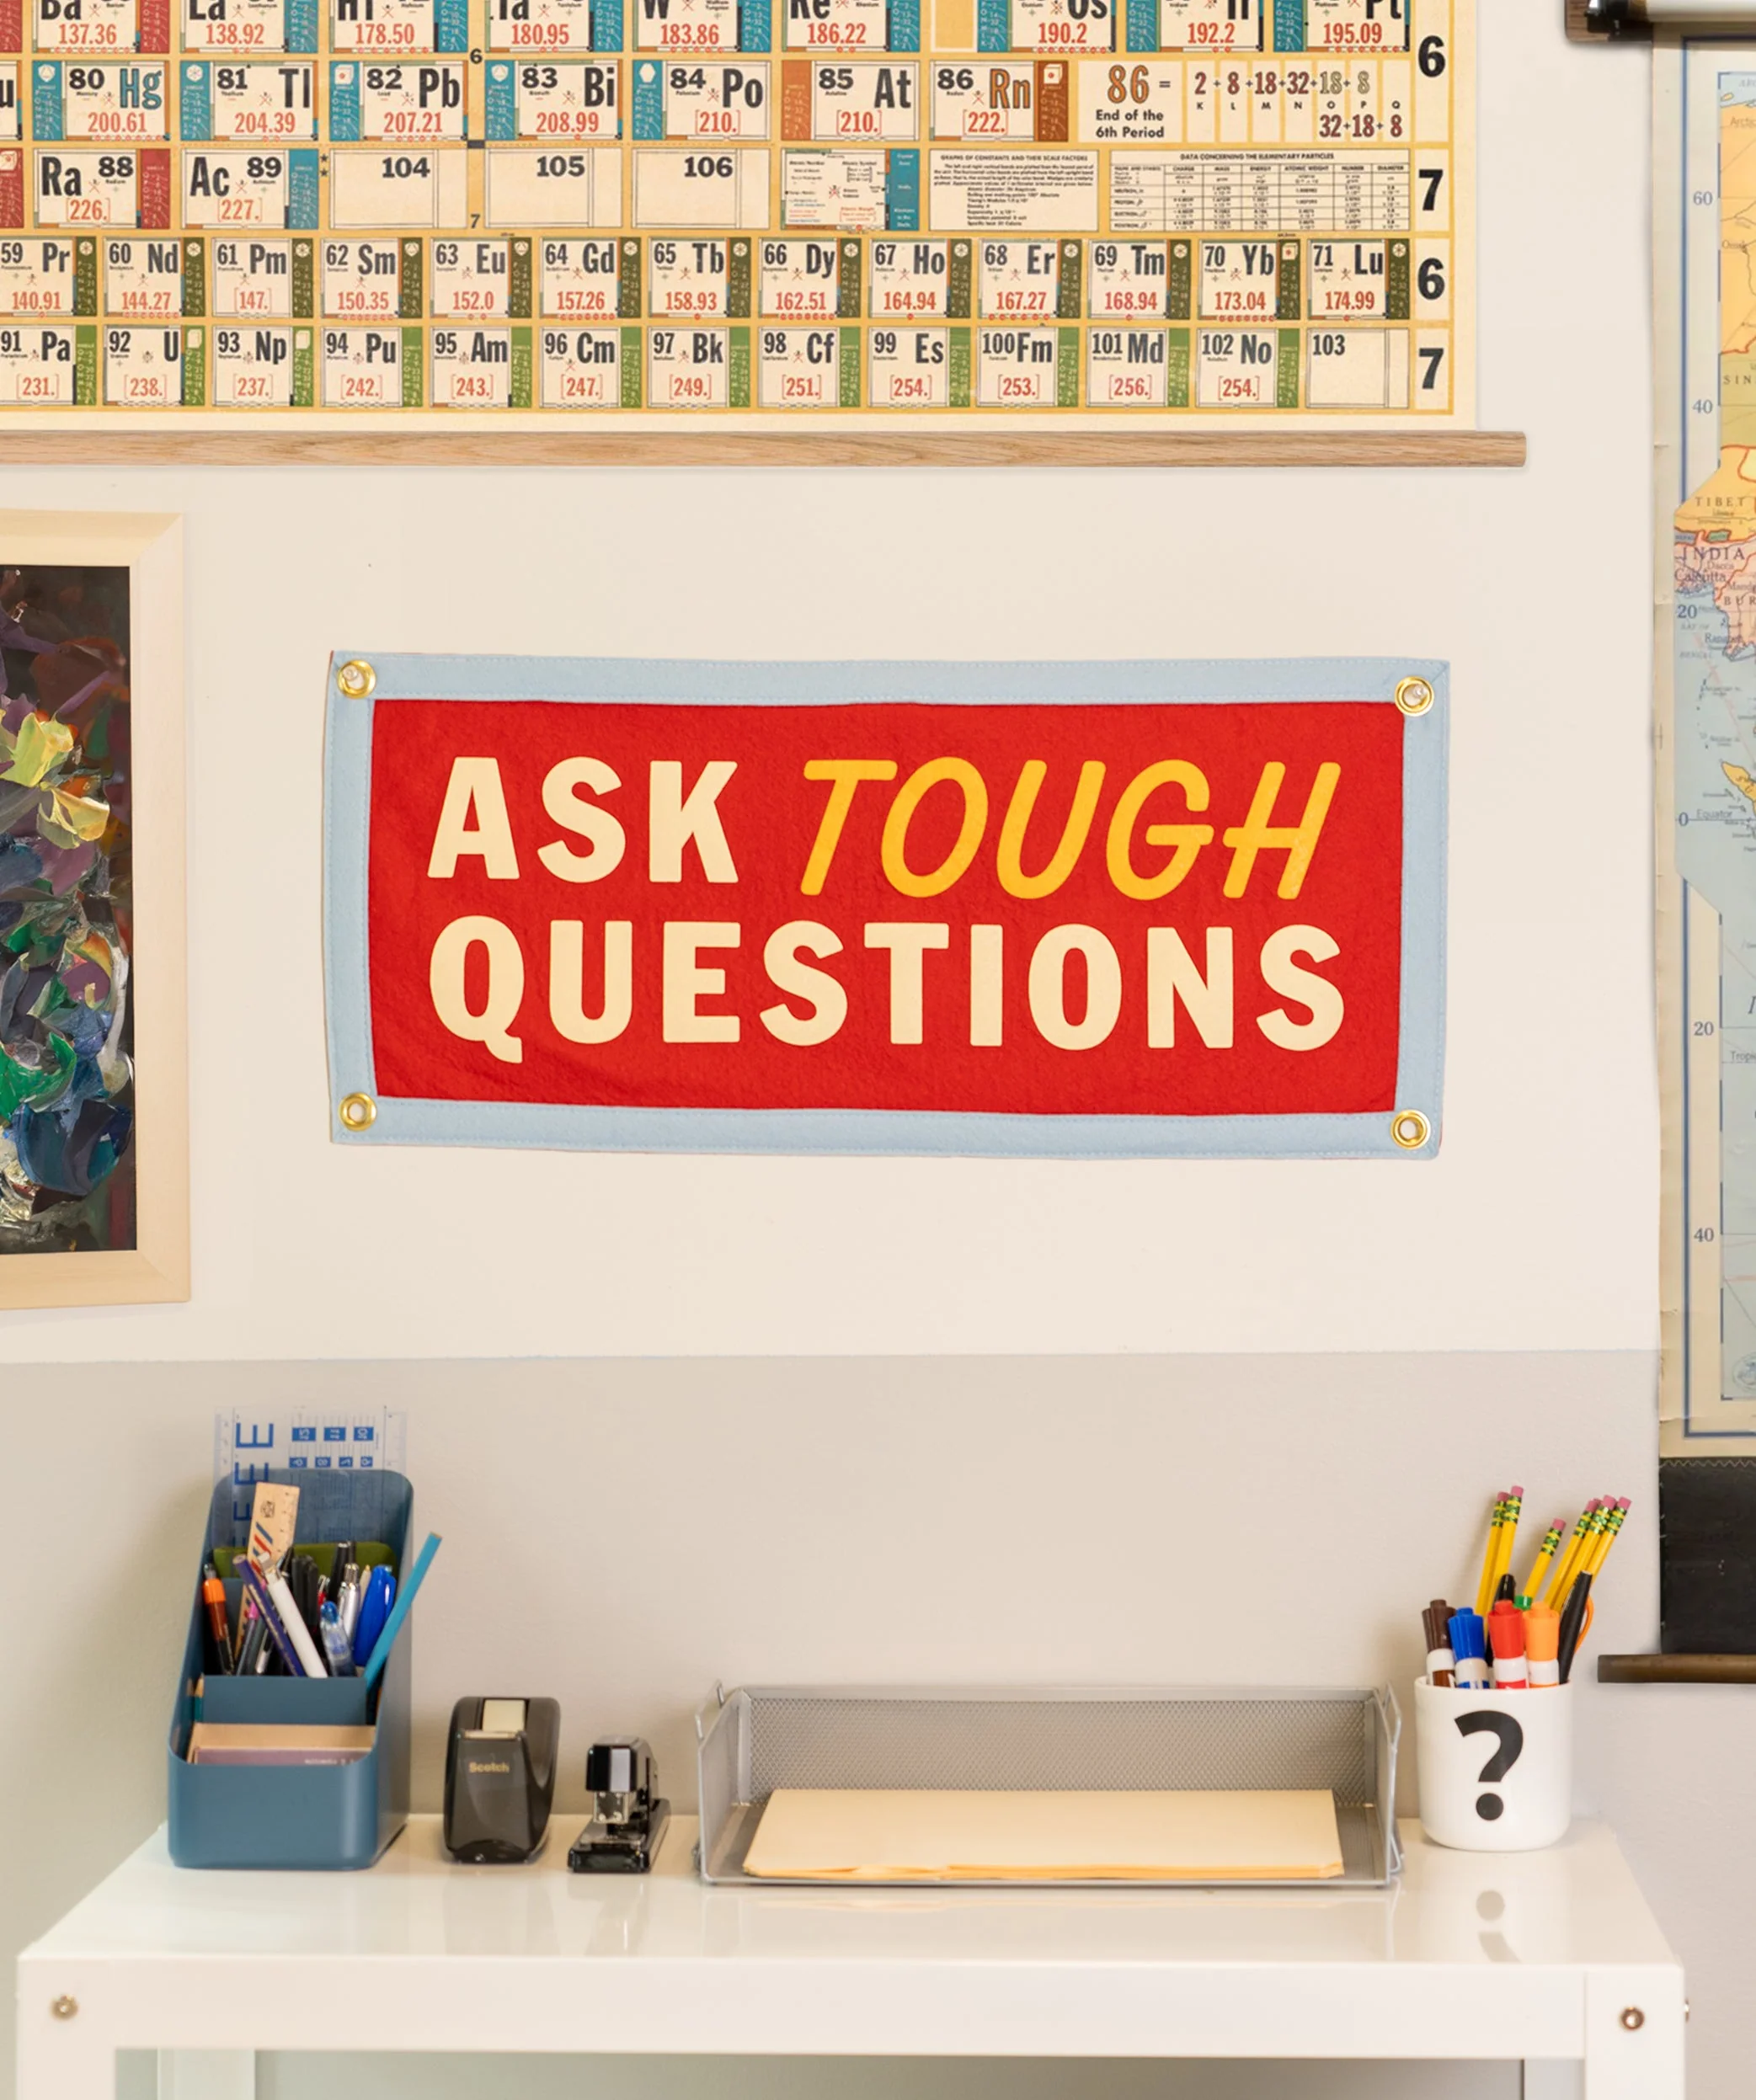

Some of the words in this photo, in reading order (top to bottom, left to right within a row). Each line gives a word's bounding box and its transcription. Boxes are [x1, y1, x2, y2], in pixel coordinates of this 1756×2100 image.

[58, 24, 117, 45] 137.36
[205, 24, 264, 45] 138.92
[355, 23, 414, 45] 178.50
[511, 23, 569, 45] 180.95
[660, 23, 719, 45] 183.86
[807, 22, 866, 44] 186.22
[1038, 22, 1086, 44] 190.2
[1188, 22, 1235, 44] 192.2
[1324, 22, 1383, 44] 195.09
[470, 49, 483, 64] 6
[1418, 35, 1445, 77] 6
[69, 68, 104, 89] 80
[120, 68, 163, 109] Hg
[217, 68, 248, 89] 81
[278, 68, 310, 108] Tl
[367, 67, 403, 90] 82
[419, 67, 460, 108] Pb
[521, 67, 558, 89] 83
[584, 67, 614, 107] Bi
[670, 67, 706, 89] 84
[723, 67, 763, 108] Po
[819, 67, 854, 89] 85
[874, 67, 911, 109] At
[937, 67, 974, 89] 86
[990, 67, 1031, 109] Rn
[1108, 64, 1149, 104] 86
[1194, 71, 1206, 95] 2
[1227, 71, 1240, 95] 8
[1255, 71, 1277, 95] 18
[1287, 71, 1309, 94] 32
[1320, 71, 1342, 94] 18
[1358, 71, 1370, 94] 8
[1097, 109, 1119, 121] End
[1125, 109, 1139, 121] of
[1142, 109, 1164, 121] the
[1327, 101, 1336, 109] O
[1392, 101, 1400, 109] Q
[88, 113, 147, 133] 200.61
[235, 113, 296, 133] 204.39
[383, 112, 443, 133] 207.21
[536, 112, 599, 133] 208.99
[1097, 126, 1118, 138] 6th
[1123, 126, 1164, 138] Period
[1319, 115, 1342, 138] 32
[1353, 115, 1374, 138] 18
[1390, 115, 1402, 138] 8
[42, 157, 82, 196] Ra
[99, 157, 134, 178] 88
[189, 157, 229, 196] Ac
[247, 157, 281, 178] 89
[382, 157, 430, 179] 104
[536, 155, 585, 177] 105
[684, 157, 733, 178] 106
[1419, 168, 1444, 211] 7
[1693, 191, 1713, 205] 60
[471, 214, 480, 228] 7
[1, 243, 24, 264] 59
[42, 243, 70, 273] Pr
[109, 243, 131, 264] 60
[148, 243, 179, 273] Nd
[217, 244, 238, 265] 61
[250, 244, 286, 274] Pm
[325, 243, 349, 266] 62
[358, 244, 396, 274] Sm
[436, 244, 458, 266] 63
[477, 244, 505, 274] Eu
[545, 244, 568, 265] 64
[583, 243, 615, 274] Gd
[654, 243, 675, 264] 65
[692, 243, 724, 274] Tb
[765, 244, 787, 265] 66
[806, 243, 835, 280] Dy
[874, 244, 896, 266] 67
[913, 244, 945, 274] Ho
[985, 244, 1007, 266] 68
[1027, 244, 1055, 274] Er
[1095, 245, 1118, 266] 69
[1131, 244, 1165, 275] Tm
[1204, 245, 1225, 266] 70
[1242, 244, 1273, 275] Yb
[1314, 246, 1334, 266] 71
[1354, 244, 1384, 275] Lu
[1418, 258, 1445, 300] 6
[12, 291, 61, 310] 140.91
[121, 291, 172, 310] 144.27
[337, 291, 389, 310] 150.35
[453, 291, 494, 310] 152.0
[557, 291, 605, 310] 157.26
[665, 291, 718, 311] 158.93
[776, 291, 826, 311] 162.51
[883, 291, 937, 311] 164.94
[996, 291, 1047, 311] 167.27
[1105, 291, 1157, 311] 168.94
[1214, 291, 1266, 311] 173.04
[1325, 291, 1374, 310] 174.99
[0, 330, 20, 352] 91
[42, 330, 71, 362] Pa
[109, 330, 131, 352] 92
[163, 331, 179, 362] U
[218, 331, 241, 353] 93
[255, 331, 286, 364] Np
[325, 332, 349, 354] 94
[366, 333, 396, 364] Pu
[435, 332, 456, 354] 95
[472, 332, 508, 364] Am
[544, 332, 568, 354] 96
[578, 332, 615, 364] Cm
[654, 332, 675, 354] 97
[692, 333, 724, 364] Bk
[764, 332, 787, 354] 98
[807, 333, 835, 364] Cf
[874, 332, 896, 354] 99
[915, 333, 944, 364] Es
[982, 333, 1016, 354] 100
[1017, 332, 1053, 364] Fm
[1091, 333, 1124, 354] 101
[1128, 333, 1164, 364] Md
[1203, 334, 1234, 355] 102
[1241, 334, 1272, 364] No
[1312, 334, 1346, 356] 103
[1419, 348, 1444, 390] 7
[1692, 399, 1713, 414] 40
[1683, 547, 1745, 559] INDIA
[1678, 605, 1697, 618] 20
[1679, 812, 1689, 827] 0
[1696, 810, 1732, 820] Equator
[428, 756, 738, 882] ASK
[800, 756, 1340, 900] TOUGH
[430, 915, 1342, 1063] QUESTIONS
[1694, 1021, 1714, 1036] 20
[1694, 1228, 1714, 1242] 40
[468, 1762, 510, 1773] Scotch
[1454, 1710, 1524, 1820] ?
